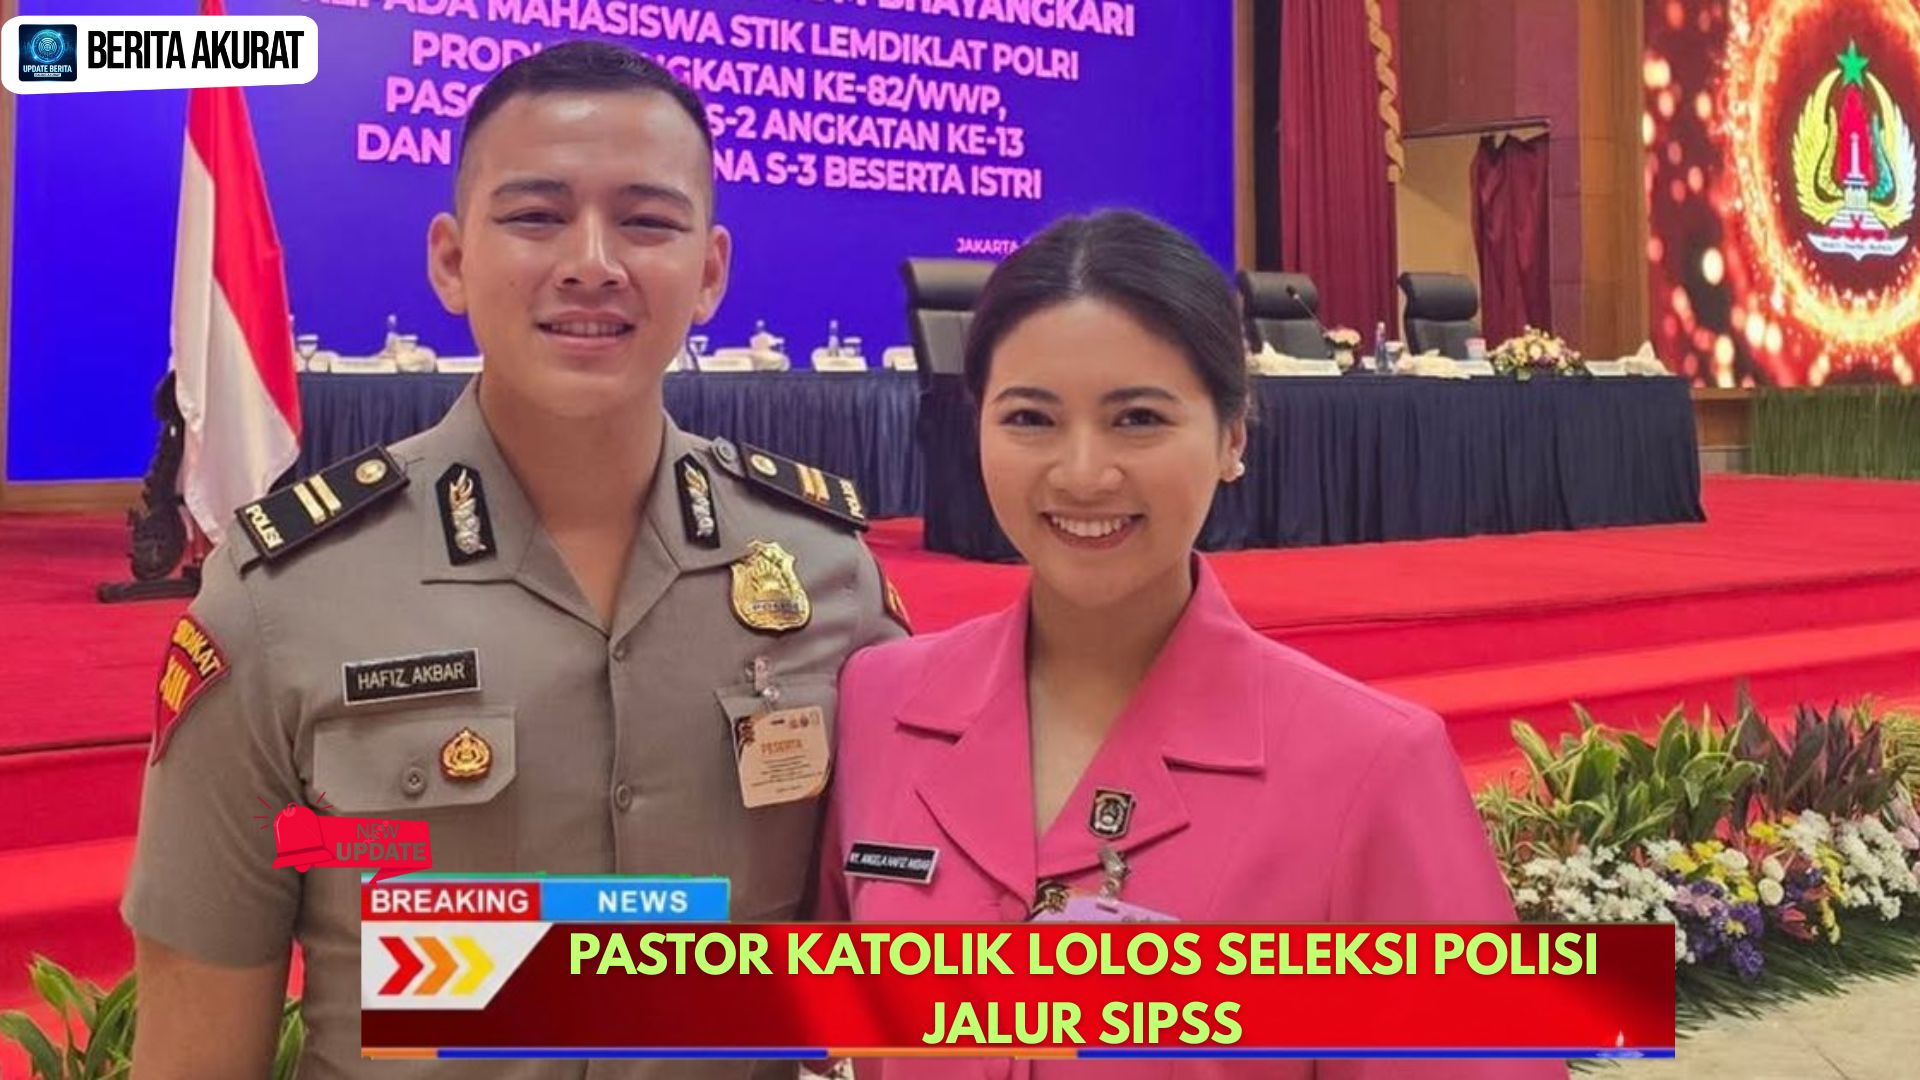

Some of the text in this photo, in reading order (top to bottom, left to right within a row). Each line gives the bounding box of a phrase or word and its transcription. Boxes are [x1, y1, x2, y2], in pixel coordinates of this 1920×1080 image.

[488, 0, 725, 46] MAHASISWA
[729, 14, 805, 54] STIK
[811, 23, 988, 72] LEMDIKLAT
[993, 42, 1080, 81] POLRI
[656, 53, 805, 100] GKATAN
[813, 69, 1007, 122] KE-82/WWP,
[356, 122, 452, 165] DAN
[765, 151, 818, 187] S-3
[823, 155, 966, 195] BESERTA
[971, 165, 1042, 200] ISTRI
[761, 108, 940, 152] ANGKATAN
[946, 121, 1025, 159] KE-13
[245, 503, 284, 549] POLISI
[357, 662, 467, 691] HAFIZ AKBAR
